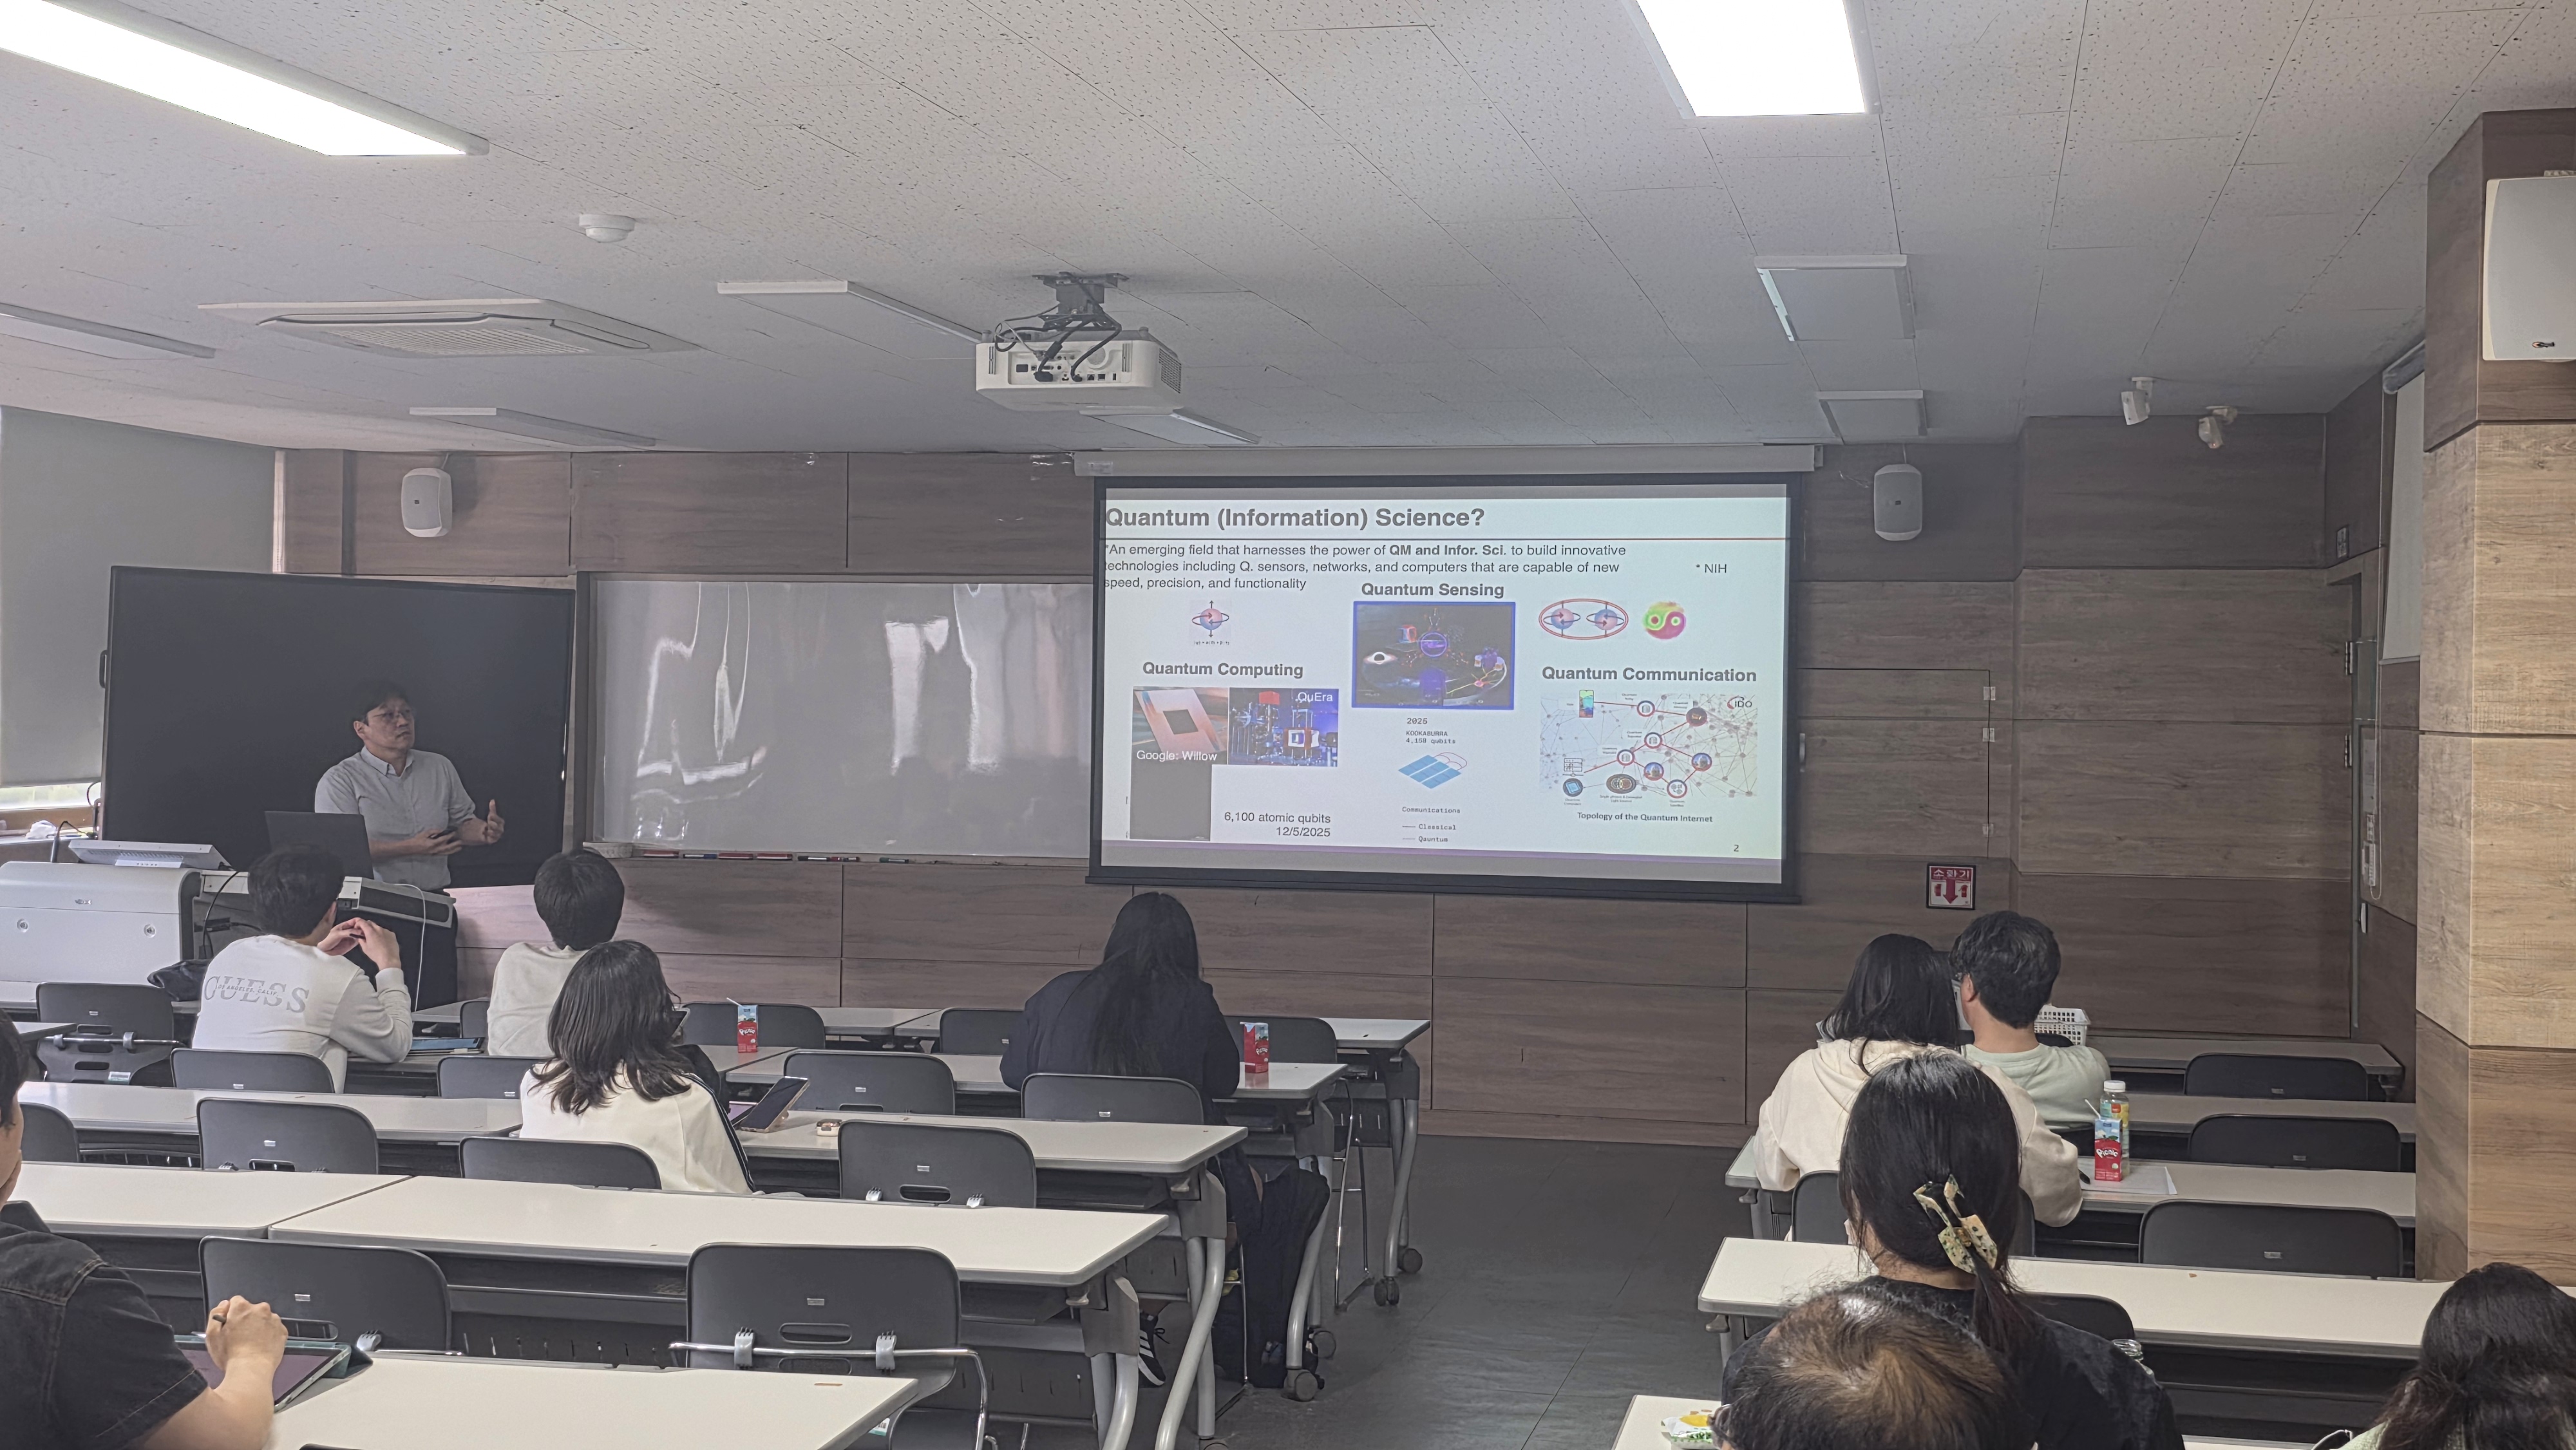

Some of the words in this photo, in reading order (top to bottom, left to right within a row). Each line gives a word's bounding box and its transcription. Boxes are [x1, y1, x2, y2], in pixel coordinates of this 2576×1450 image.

[1105, 508, 1209, 527] Quantum
[1217, 508, 1368, 531] (Information)
[1376, 508, 1485, 527] Science?
[1129, 545, 1184, 557] emerging
[1189, 544, 1213, 556] field
[1217, 545, 1240, 556] that
[1244, 545, 1305, 556] harnesses
[1310, 545, 1329, 556] the
[1332, 547, 1371, 558] power
[1374, 545, 1387, 556] of
[1389, 545, 1411, 556] QM
[1416, 545, 1440, 556] and
[1444, 545, 1477, 556] Infor.
[1482, 545, 1506, 556] Sci.
[1511, 545, 1523, 556] to
[1527, 545, 1557, 556] build
[1561, 545, 1626, 556] innovative
[1182, 561, 1235, 573] including
[1240, 561, 1253, 572] Q.
[1258, 563, 1308, 574] sensors,
[1312, 561, 1370, 574] networks,
[1375, 562, 1398, 572] and
[1401, 563, 1467, 574] computers
[1471, 562, 1495, 573] that
[1499, 564, 1519, 573] are
[1522, 562, 1573, 574] capable
[1577, 562, 1589, 573] of
[1593, 564, 1619, 573] new
[1704, 563, 1727, 573] NIH
[1104, 578, 1143, 590] speed,
[1147, 578, 1204, 590] precision,
[1208, 578, 1231, 588] and
[1234, 578, 1306, 591] functionality
[1361, 583, 1434, 596] Quantum
[1439, 583, 1504, 599] Sensing
[1142, 662, 1213, 675] Quantum
[1217, 663, 1303, 679] Computing
[1542, 666, 1617, 680] Quantum
[1622, 667, 1757, 682] Communication
[1297, 692, 1333, 702] QuEra
[1136, 750, 1179, 762] Google:
[1182, 751, 1217, 761] Willow
[1224, 811, 1255, 822] 6,100
[1258, 813, 1294, 823] atomic
[1298, 813, 1331, 824] qubits
[1577, 812, 1613, 821] Topology
[1276, 826, 1331, 837] 12/5/2025
[2096, 1148, 2119, 1158] Picnic
